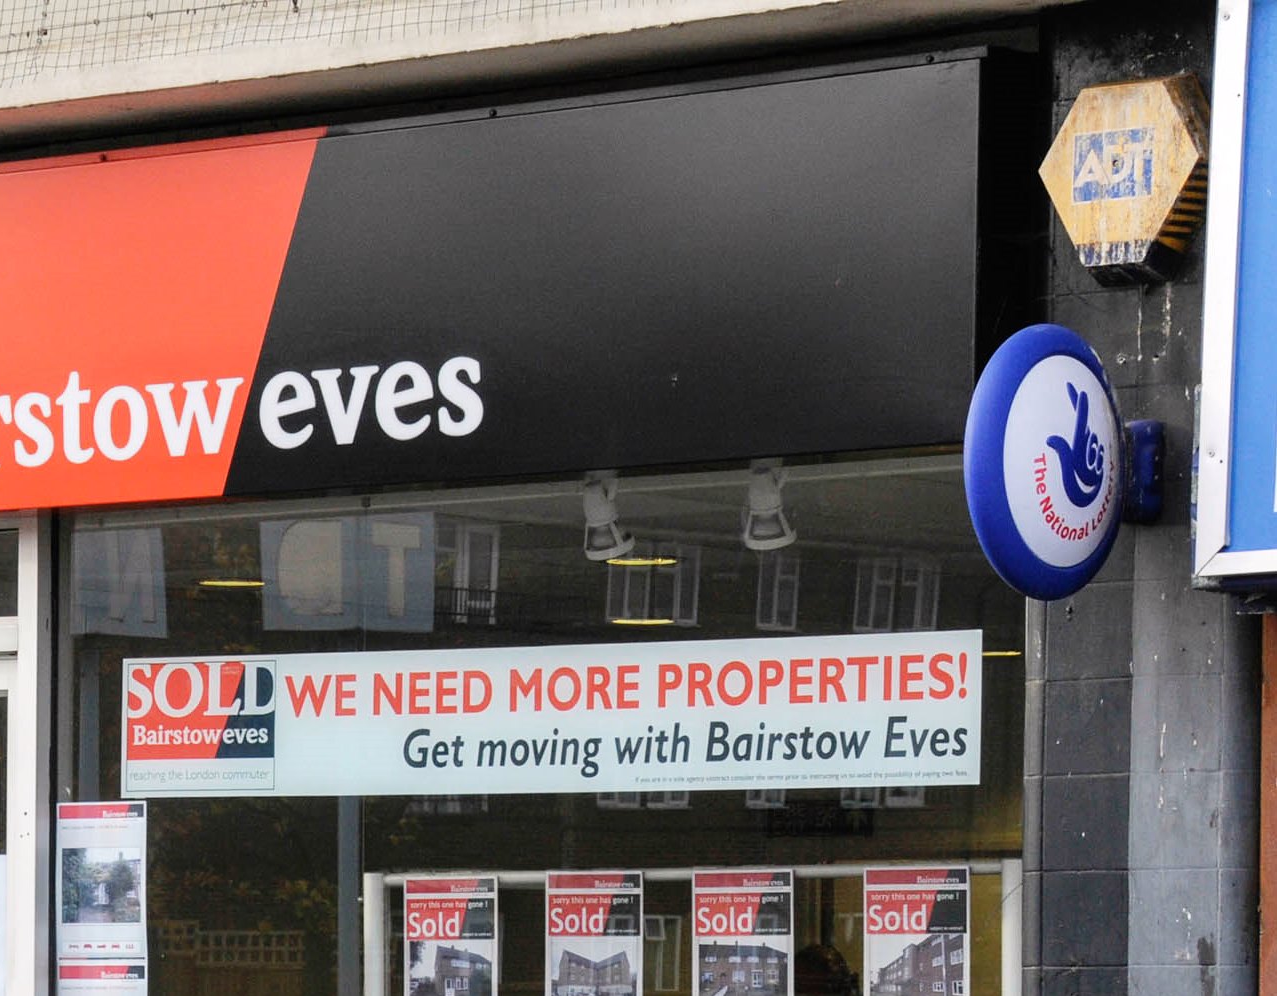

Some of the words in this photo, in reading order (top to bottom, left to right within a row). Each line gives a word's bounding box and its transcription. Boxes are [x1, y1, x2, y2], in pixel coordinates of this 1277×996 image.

[1074, 139, 1151, 188] ADT
[258, 355, 484, 450] eves
[1033, 452, 1047, 494] The
[1039, 495, 1089, 541] National
[127, 662, 275, 719] SOLD
[284, 673, 357, 718] WE
[373, 670, 493, 716] NEED
[509, 665, 640, 713] MORE
[657, 652, 969, 709] PROPERTIES!
[132, 724, 222, 746] Bairstow
[222, 727, 269, 745] eves
[403, 728, 464, 768] Get
[477, 728, 602, 778] moving
[615, 722, 691, 764] with
[705, 720, 871, 763] Bairstow
[884, 715, 969, 758] Eves
[129, 770, 166, 783] reaching
[168, 770, 183, 780] the
[185, 769, 220, 780] London
[222, 770, 269, 780] commuter
[408, 911, 460, 938] Sold
[550, 907, 604, 933] Sold
[697, 906, 753, 933] Sold
[869, 904, 927, 931] Sold
